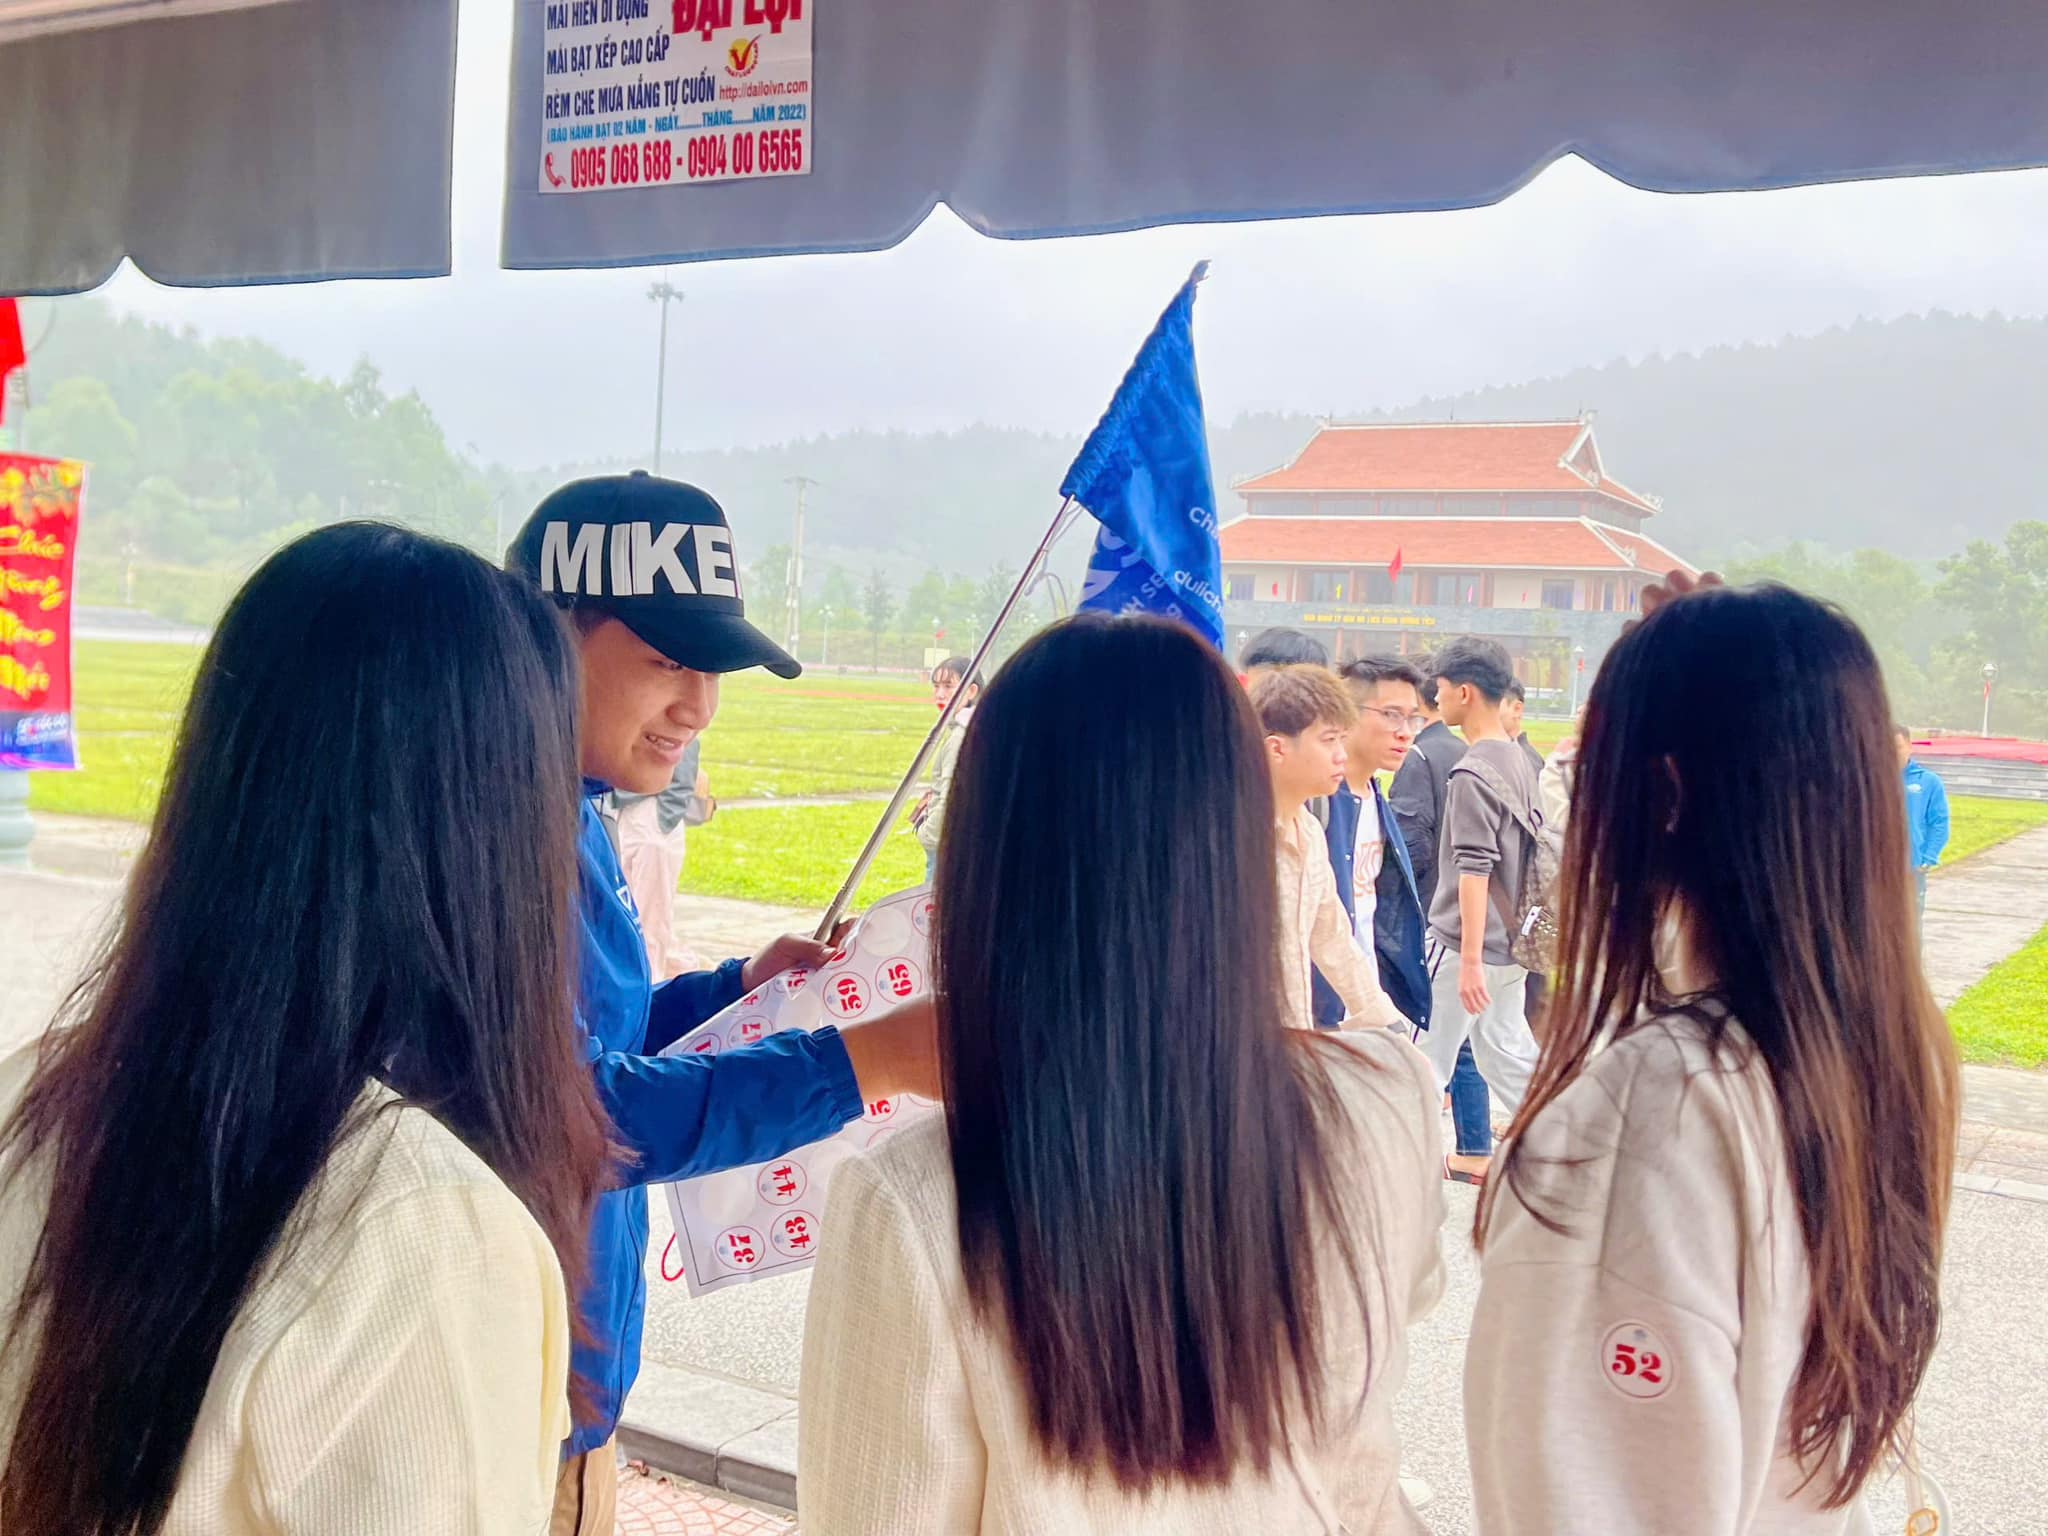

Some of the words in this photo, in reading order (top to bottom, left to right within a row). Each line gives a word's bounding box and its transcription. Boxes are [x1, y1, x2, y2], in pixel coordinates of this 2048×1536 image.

[602, 0, 613, 23] DI
[571, 45, 593, 77] BẠT
[595, 33, 617, 69] XẾP
[620, 38, 643, 66] CAO
[646, 25, 670, 63] CẤP
[574, 88, 595, 116] CHE
[598, 83, 623, 113] MƯA
[627, 73, 660, 110] NẮNG
[664, 76, 681, 112] TỰ
[681, 66, 715, 105] CUỐN
[613, 120, 624, 137] 02
[571, 146, 607, 189] 0905
[611, 143, 639, 184] 068
[643, 139, 672, 182] 688
[688, 133, 727, 178] 0904
[732, 131, 754, 174] 00
[759, 128, 802, 173] 6565
[540, 520, 744, 599] MIKE
[837, 978, 863, 1012] 59
[887, 963, 913, 996] 65
[869, 1099, 891, 1117] 5
[773, 1165, 797, 1197] 44
[728, 1233, 755, 1263] 37
[785, 1216, 811, 1249] 43
[1611, 1343, 1662, 1384] 52
